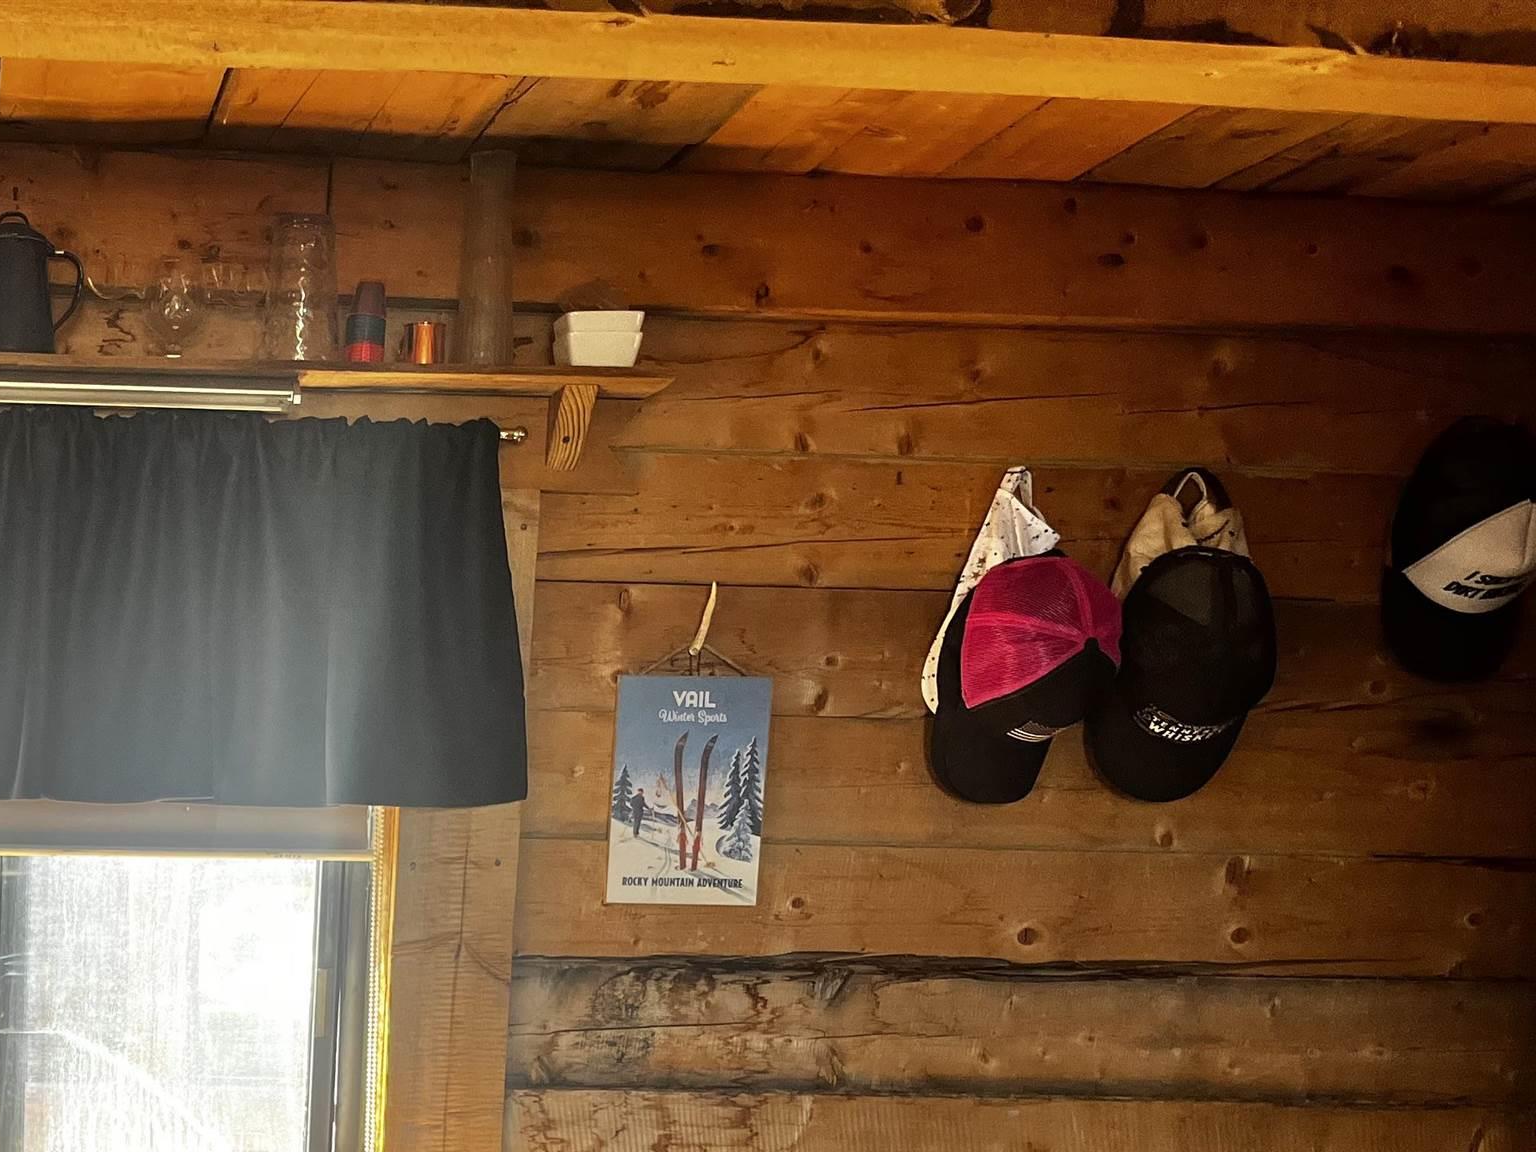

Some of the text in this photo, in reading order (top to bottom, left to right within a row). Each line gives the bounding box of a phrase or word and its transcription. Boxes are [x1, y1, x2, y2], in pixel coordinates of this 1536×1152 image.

[672, 690, 717, 709] VAIL
[658, 708, 728, 725] Winter Sports
[621, 876, 743, 889] ROCKY MOUNTAIN ADVENTURE
